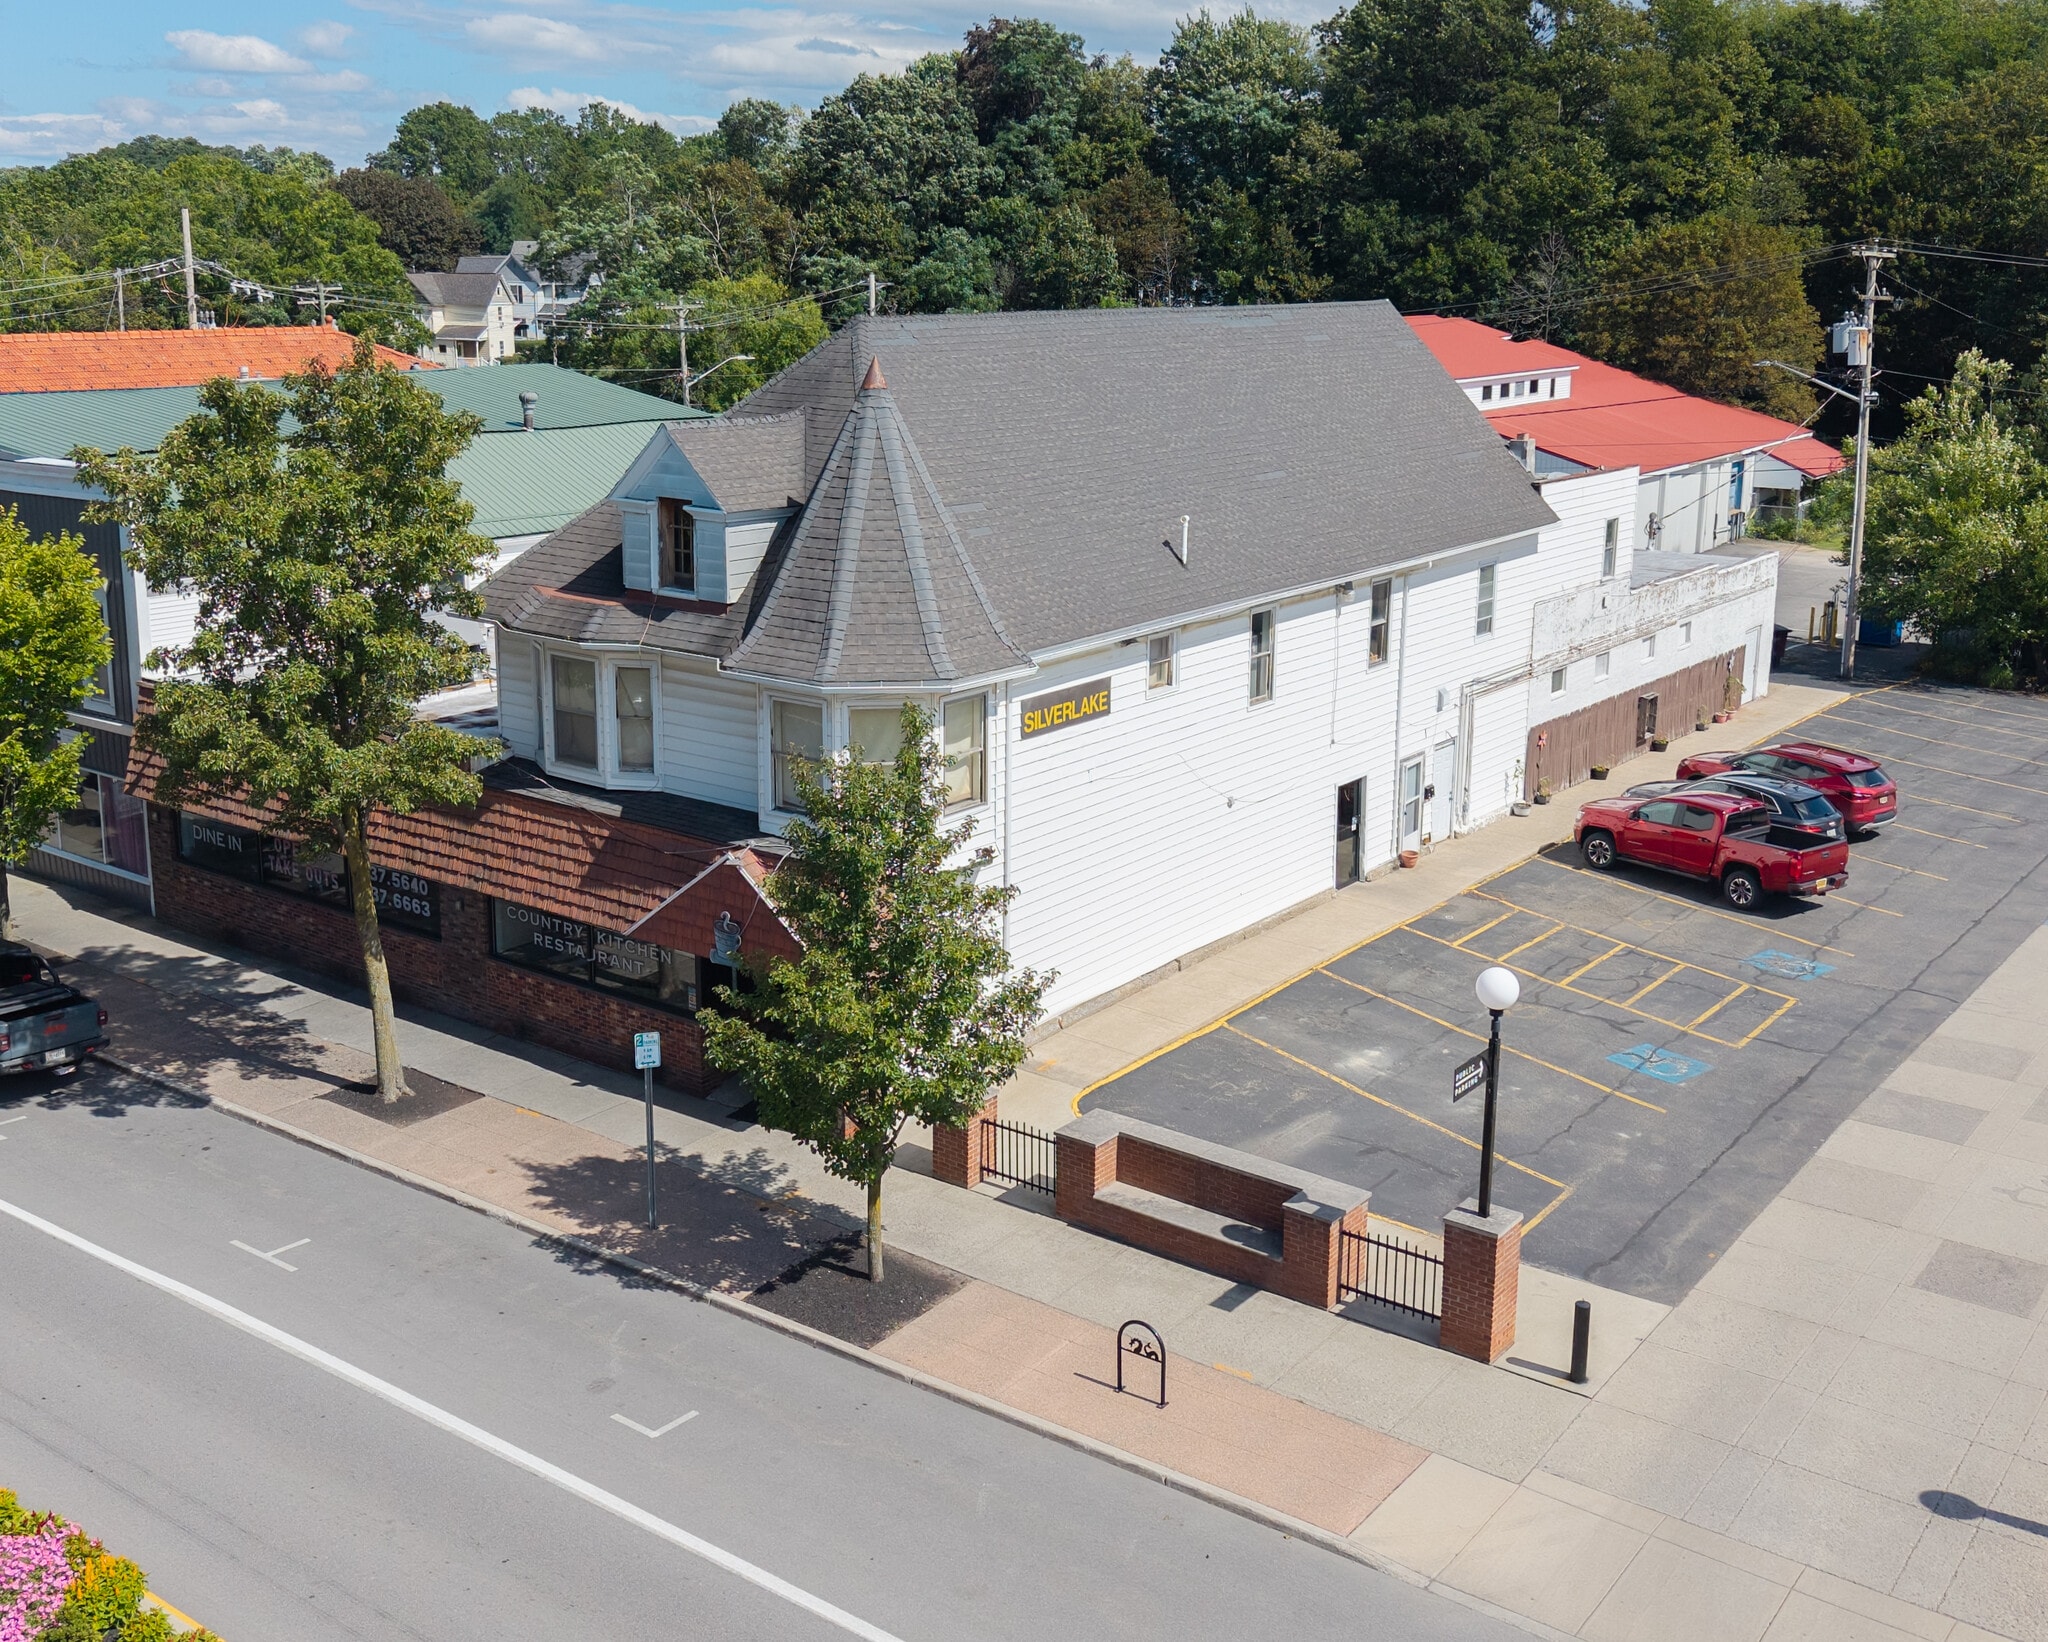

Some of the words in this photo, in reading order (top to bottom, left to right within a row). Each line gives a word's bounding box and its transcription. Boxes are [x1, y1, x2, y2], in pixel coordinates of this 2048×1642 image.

[1023, 690, 1109, 734] SILVERLAKE
[192, 824, 226, 848] DINE
[228, 834, 242, 852] IN
[273, 838, 301, 857] OPE
[268, 854, 300, 879] TAKE
[305, 865, 339, 890] OUTS
[370, 866, 429, 896] 37.5640
[372, 886, 432, 918] 37.6663
[506, 905, 584, 938] COUNTRY
[596, 930, 672, 965] KITCHEN
[533, 931, 644, 975] RESTAURANT
[636, 1036, 643, 1046] 2
[1454, 1075, 1478, 1097] PARKING
[1455, 1064, 1475, 1082] PUBLIC
